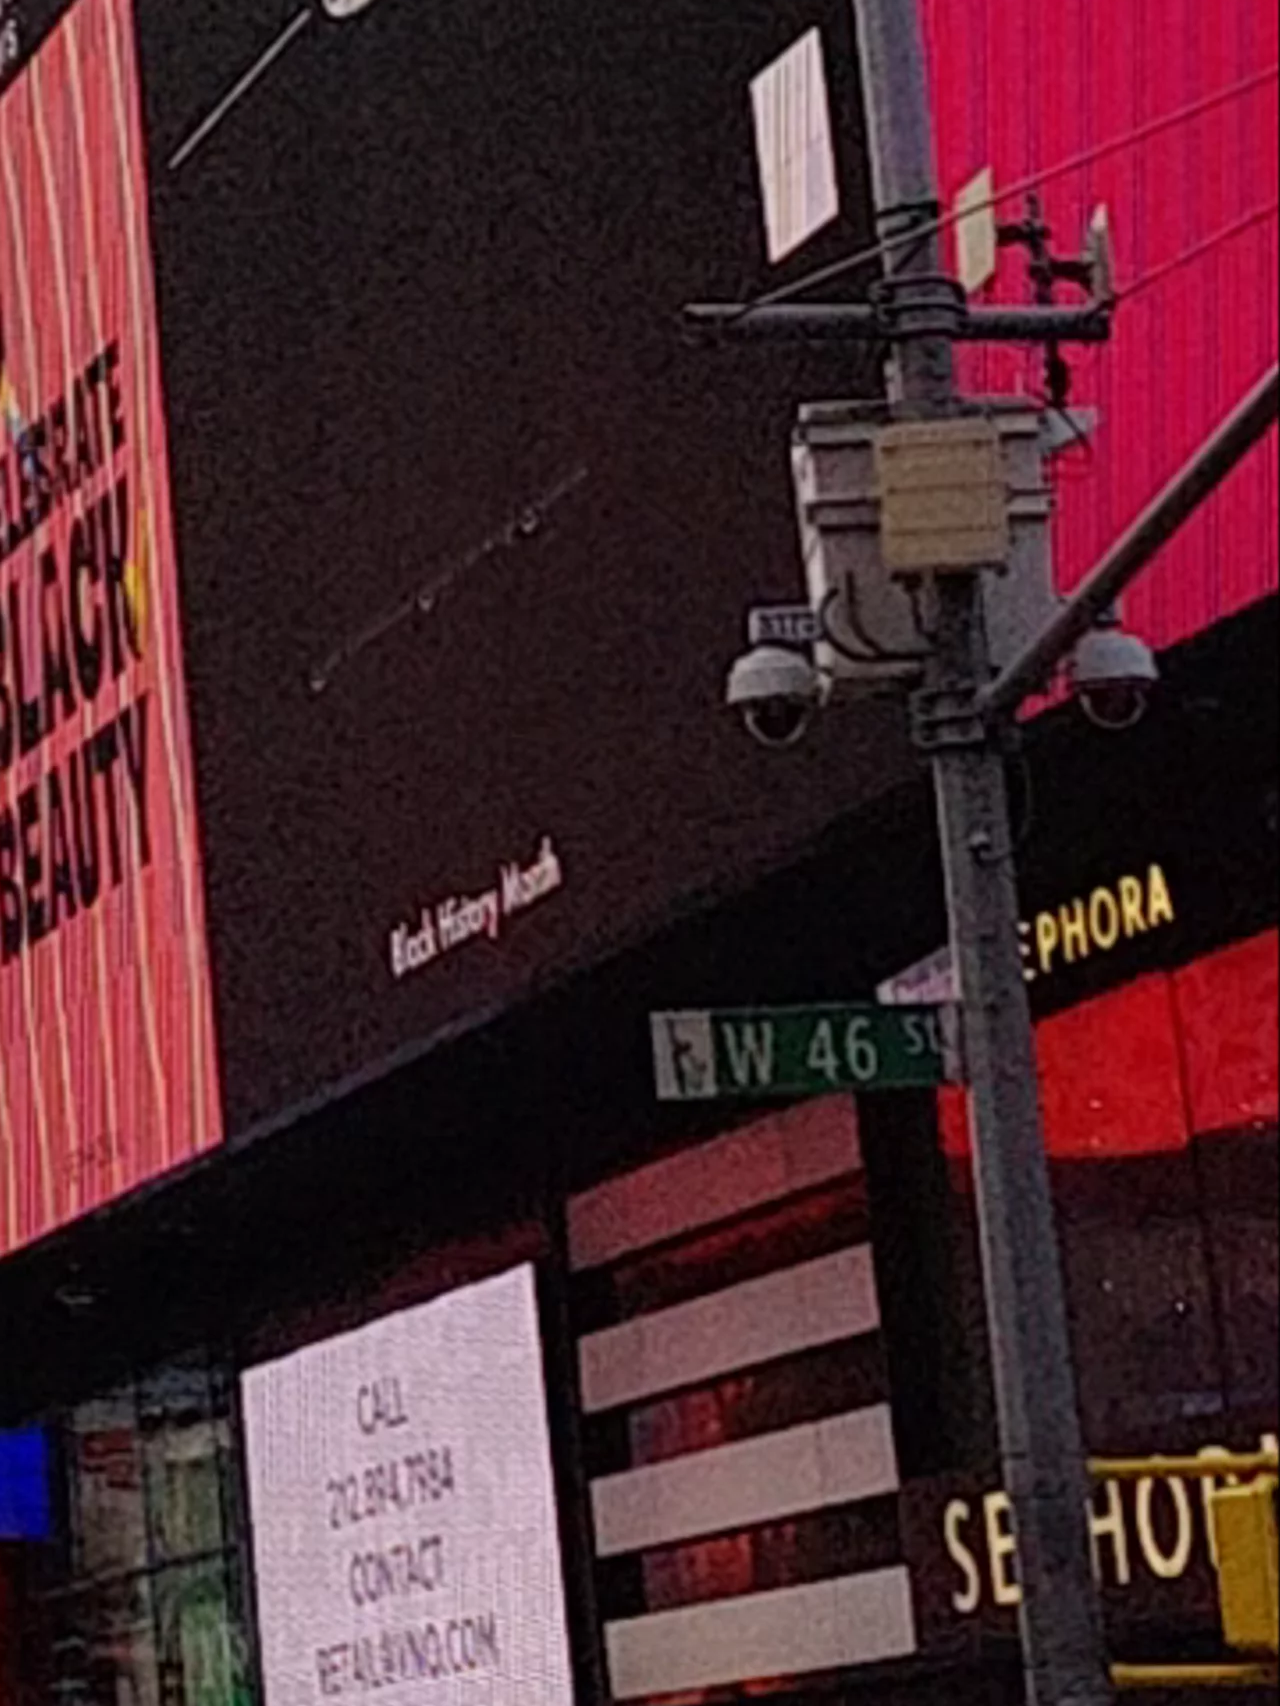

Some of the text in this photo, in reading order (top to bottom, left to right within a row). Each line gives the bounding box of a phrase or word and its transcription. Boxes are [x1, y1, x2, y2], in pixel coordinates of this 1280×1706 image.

[723, 1020, 773, 1085] W
[807, 1015, 878, 1081] 46
[349, 1533, 444, 1607] CONTACT
